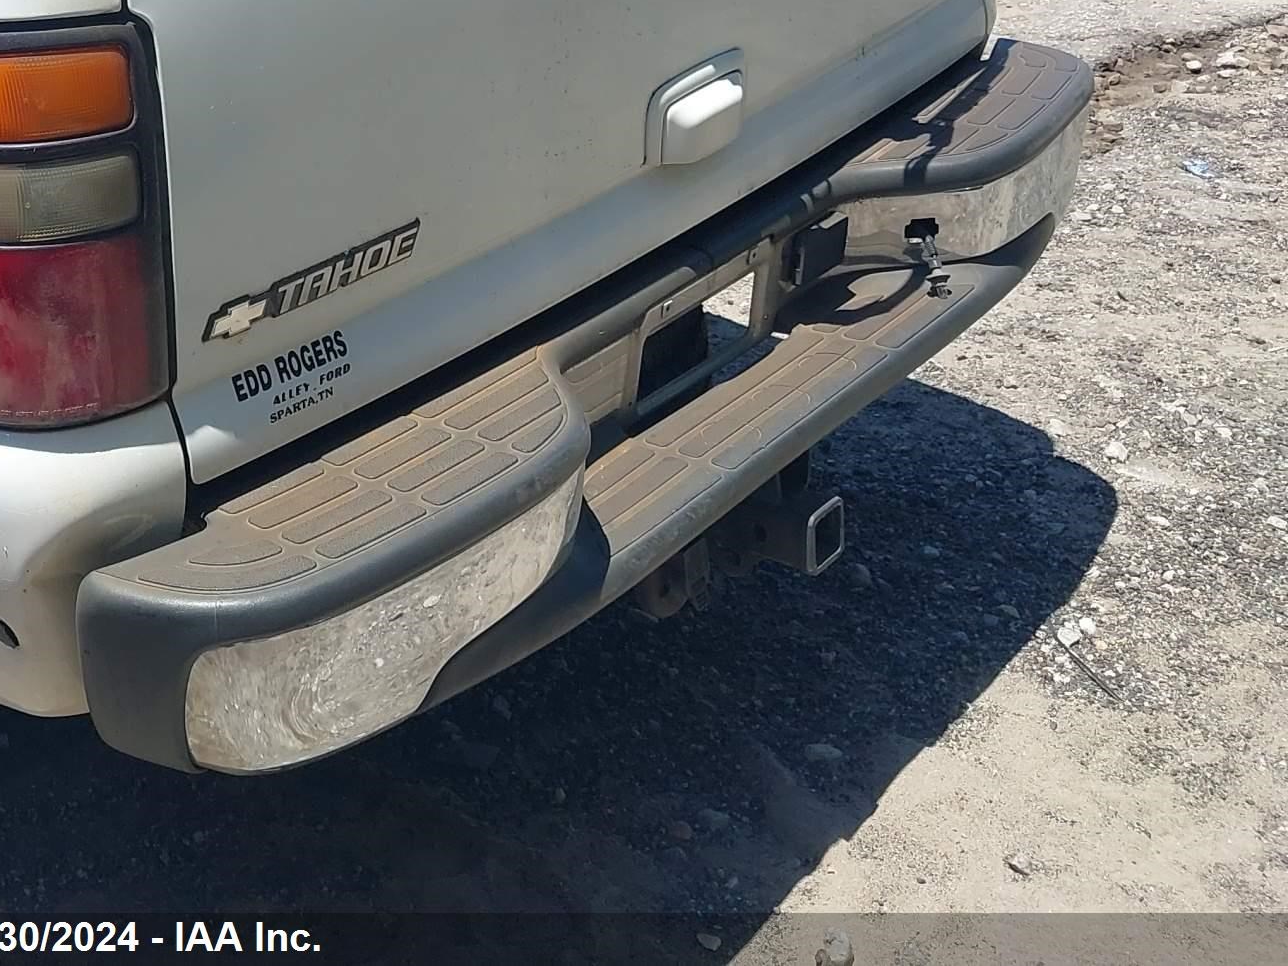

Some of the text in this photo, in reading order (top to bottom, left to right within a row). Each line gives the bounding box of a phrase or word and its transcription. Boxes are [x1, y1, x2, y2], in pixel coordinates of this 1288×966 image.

[278, 226, 419, 315] TAHOE
[231, 330, 348, 403] EDD ROGERS
[273, 363, 351, 405] ALLEY FORD
